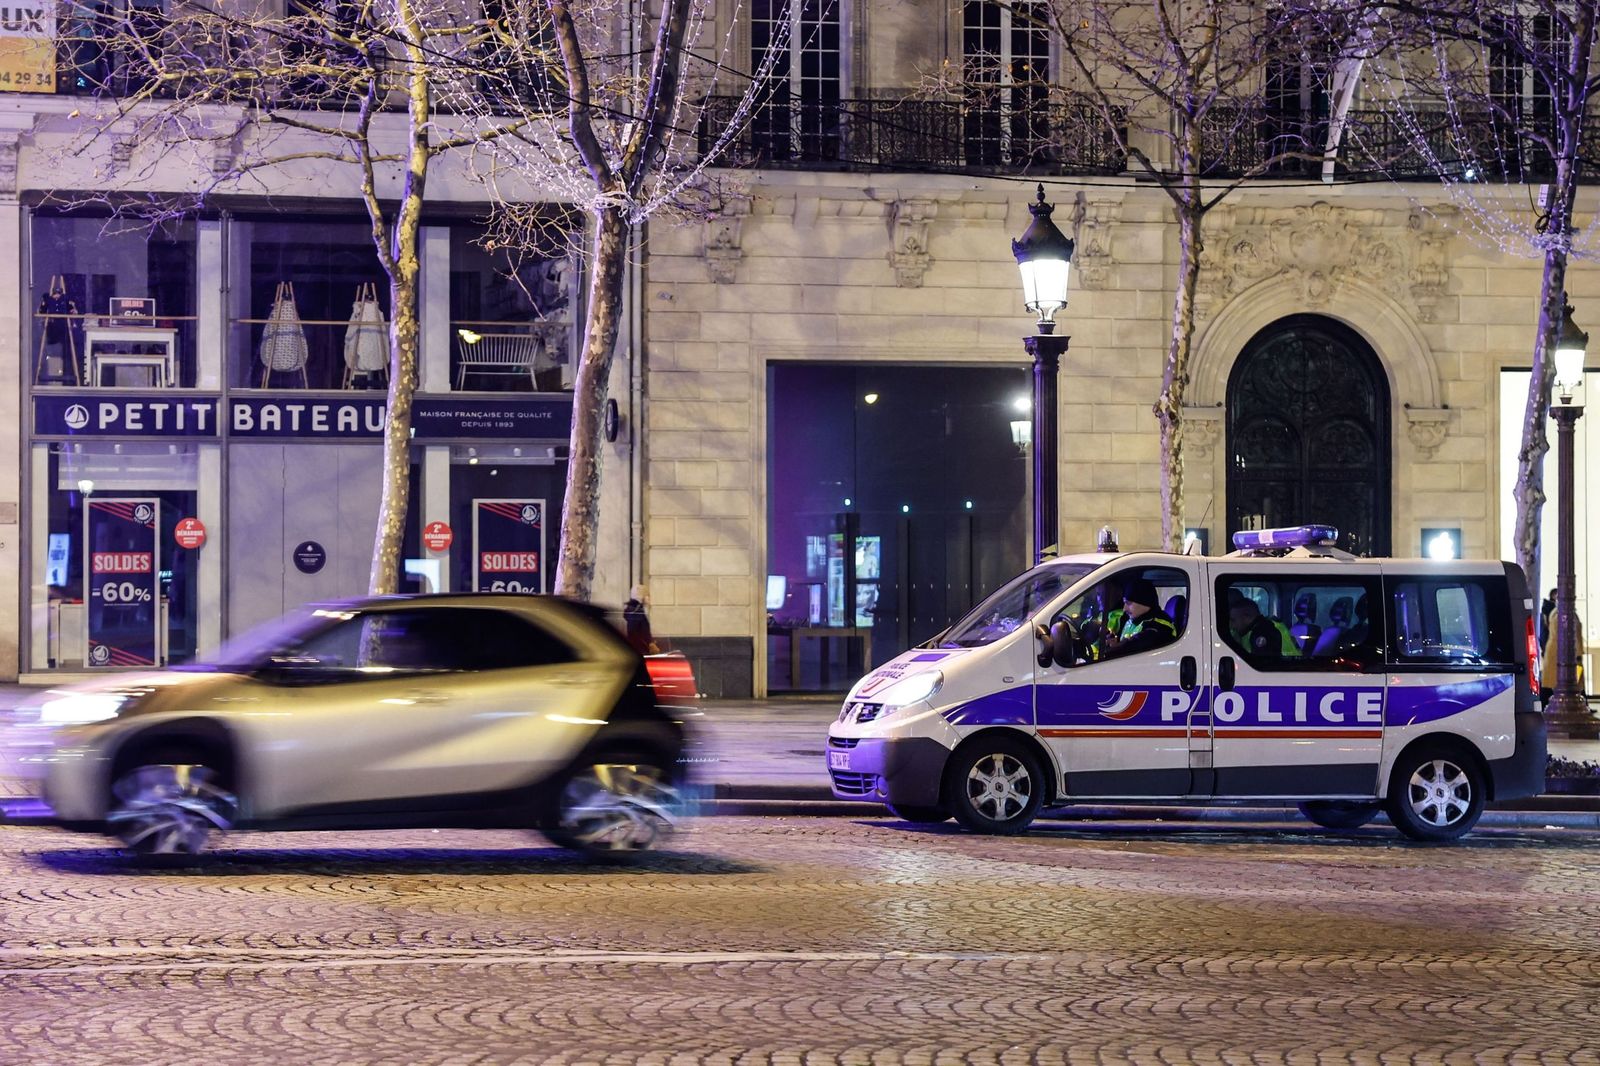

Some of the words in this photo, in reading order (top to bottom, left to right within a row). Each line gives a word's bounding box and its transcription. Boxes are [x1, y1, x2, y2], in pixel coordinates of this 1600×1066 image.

[1, 7, 44, 32] UX
[0, 71, 11, 83] 4
[15, 72, 31, 84] 29
[36, 73, 52, 85] 34
[99, 403, 211, 430] PETIT
[233, 403, 386, 432] BATEAU
[454, 411, 502, 420] FRANÇAISE
[94, 554, 149, 571] SOLDES
[484, 554, 536, 570] SOLDES
[92, 582, 151, 602] -60%
[1160, 690, 1383, 722] POLICE
